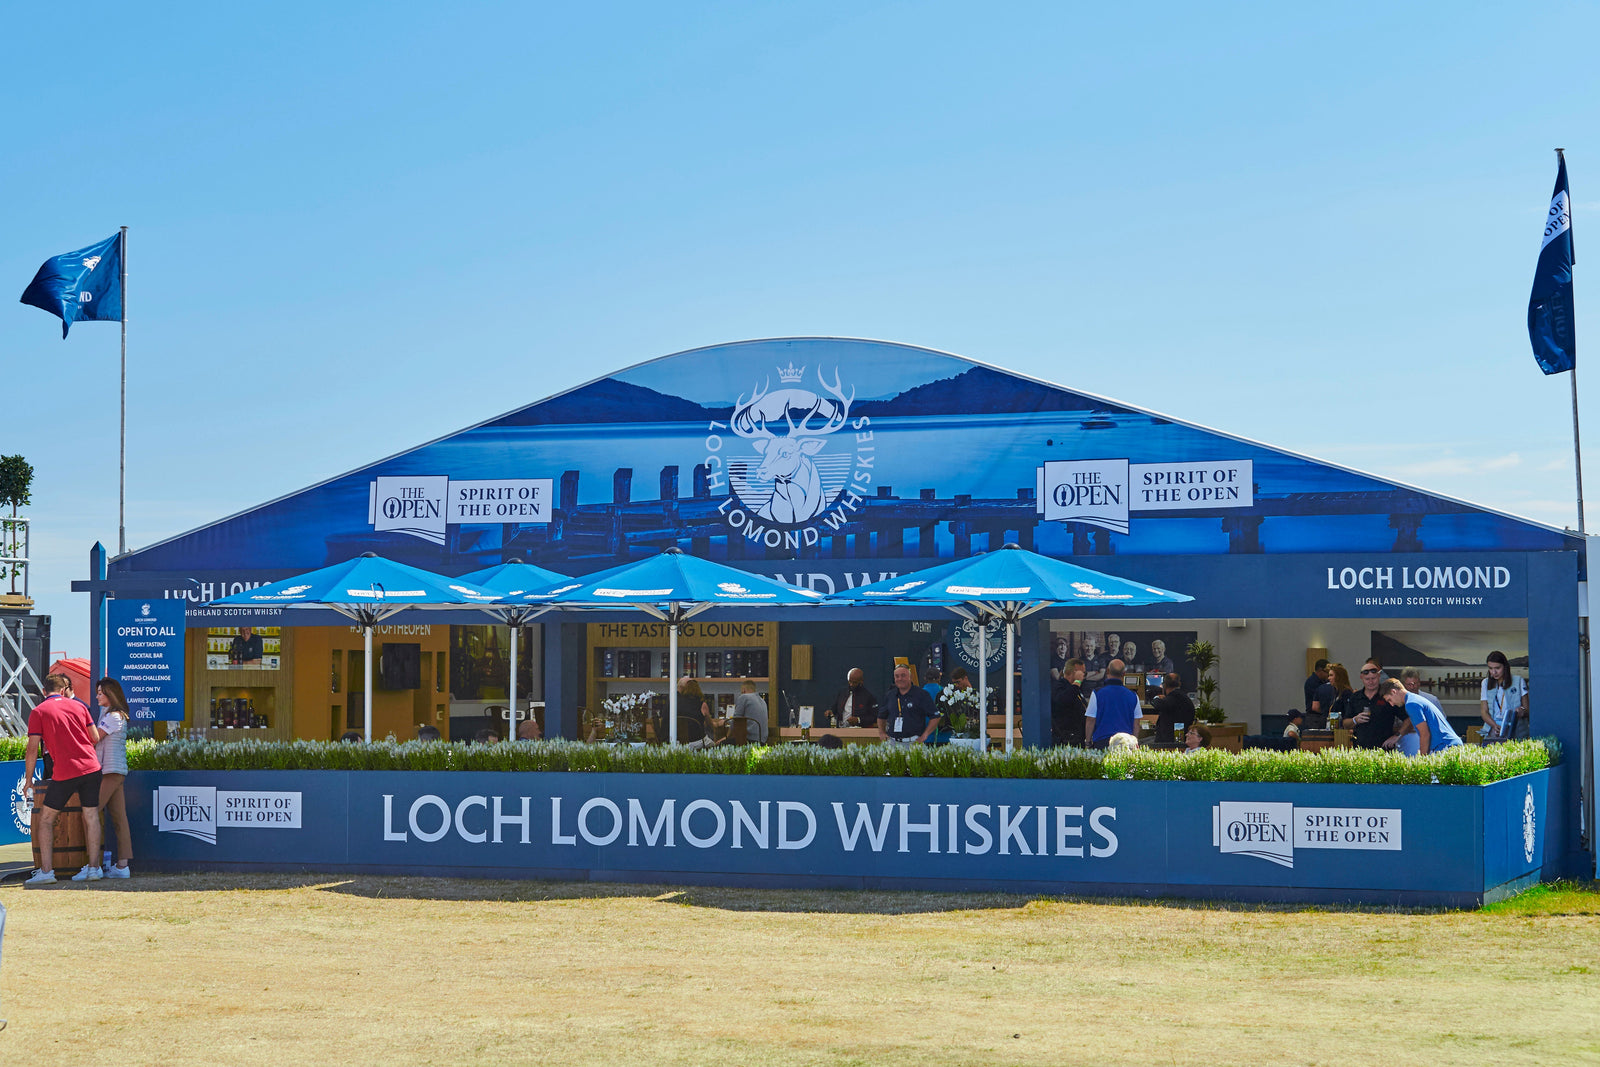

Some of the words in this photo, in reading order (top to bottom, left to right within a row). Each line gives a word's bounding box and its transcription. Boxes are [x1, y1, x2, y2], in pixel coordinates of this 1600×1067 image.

[1550, 201, 1563, 215] OF
[705, 421, 727, 490] LOCH
[718, 498, 818, 549] LOMOND
[824, 416, 875, 531] WHISKIES
[1072, 472, 1101, 484] THE
[1144, 470, 1207, 485] SPIRIT
[1213, 469, 1238, 482] OF
[400, 487, 424, 498] THE
[460, 488, 514, 500] SPIRIT
[519, 487, 539, 499] OF
[1053, 484, 1121, 506] OPEN
[1142, 488, 1181, 502] THE
[1188, 486, 1239, 500] OPEN
[383, 497, 441, 519] OPEN
[458, 504, 491, 516] THE
[496, 503, 540, 516] OPEN
[1328, 567, 1394, 589] LOCH
[1402, 566, 1511, 589] LOMOND
[1355, 597, 1402, 605] HIGHLAND
[1407, 597, 1443, 605] SCOTCH
[118, 627, 143, 636] OPEN
[145, 627, 158, 636] TO
[159, 627, 176, 636] ALL
[600, 624, 627, 637] THE
[632, 624, 695, 637] TASTG
[700, 623, 764, 637] LOUNGE
[959, 651, 991, 667] LOMOD
[136, 710, 156, 718] OPEN
[178, 795, 198, 805] THE
[226, 798, 272, 809] SPIRIT
[274, 798, 292, 809] OF
[164, 803, 211, 823] OPEN
[225, 811, 253, 822] THE
[256, 811, 292, 822] OPEN
[1244, 812, 1269, 823] THE
[382, 794, 532, 844] LOCH
[550, 797, 817, 849] LOMOND
[831, 802, 1119, 858] WHISKIES
[1306, 815, 1362, 827] SPIRIT
[1367, 816, 1388, 828] OF
[1227, 821, 1286, 842] OPEN
[1305, 830, 1338, 842] THE
[1344, 831, 1390, 843] OPEN
